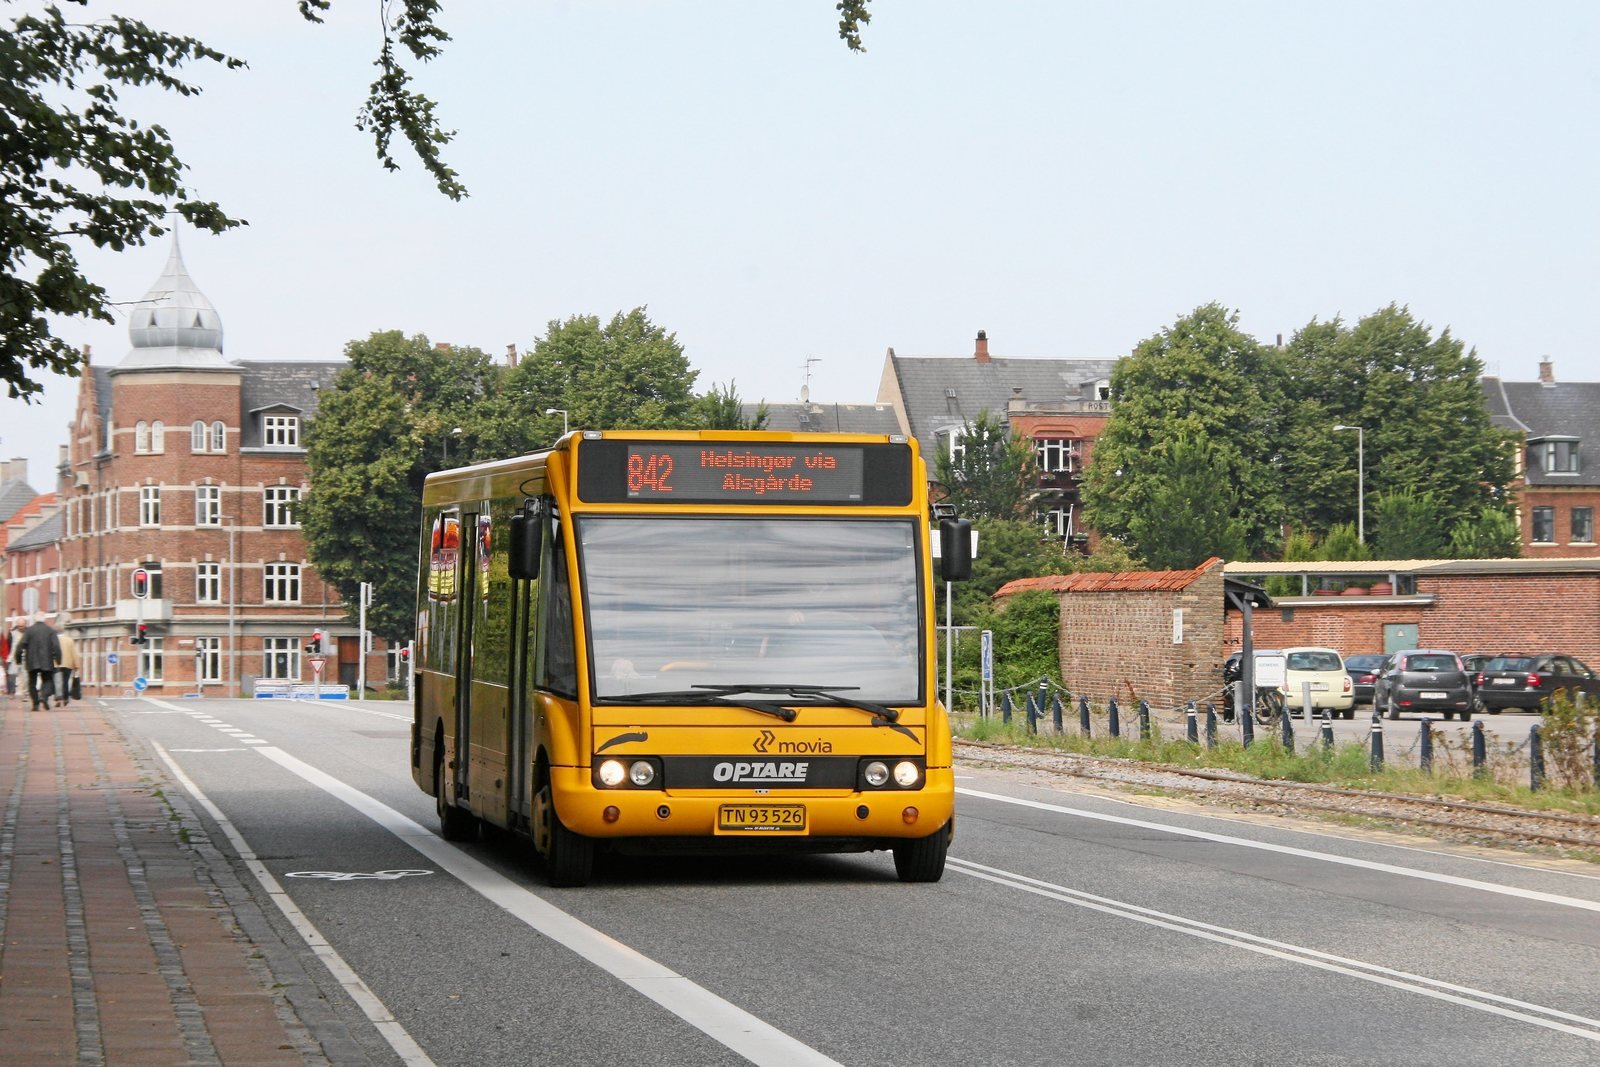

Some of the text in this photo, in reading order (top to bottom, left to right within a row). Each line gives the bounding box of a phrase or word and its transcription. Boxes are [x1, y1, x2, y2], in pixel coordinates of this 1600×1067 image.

[701, 451, 836, 472] Helsingør via
[628, 454, 673, 491] 842
[778, 737, 833, 753] movia
[713, 762, 809, 782] OPTARE
[723, 809, 802, 823] TN 93 526
